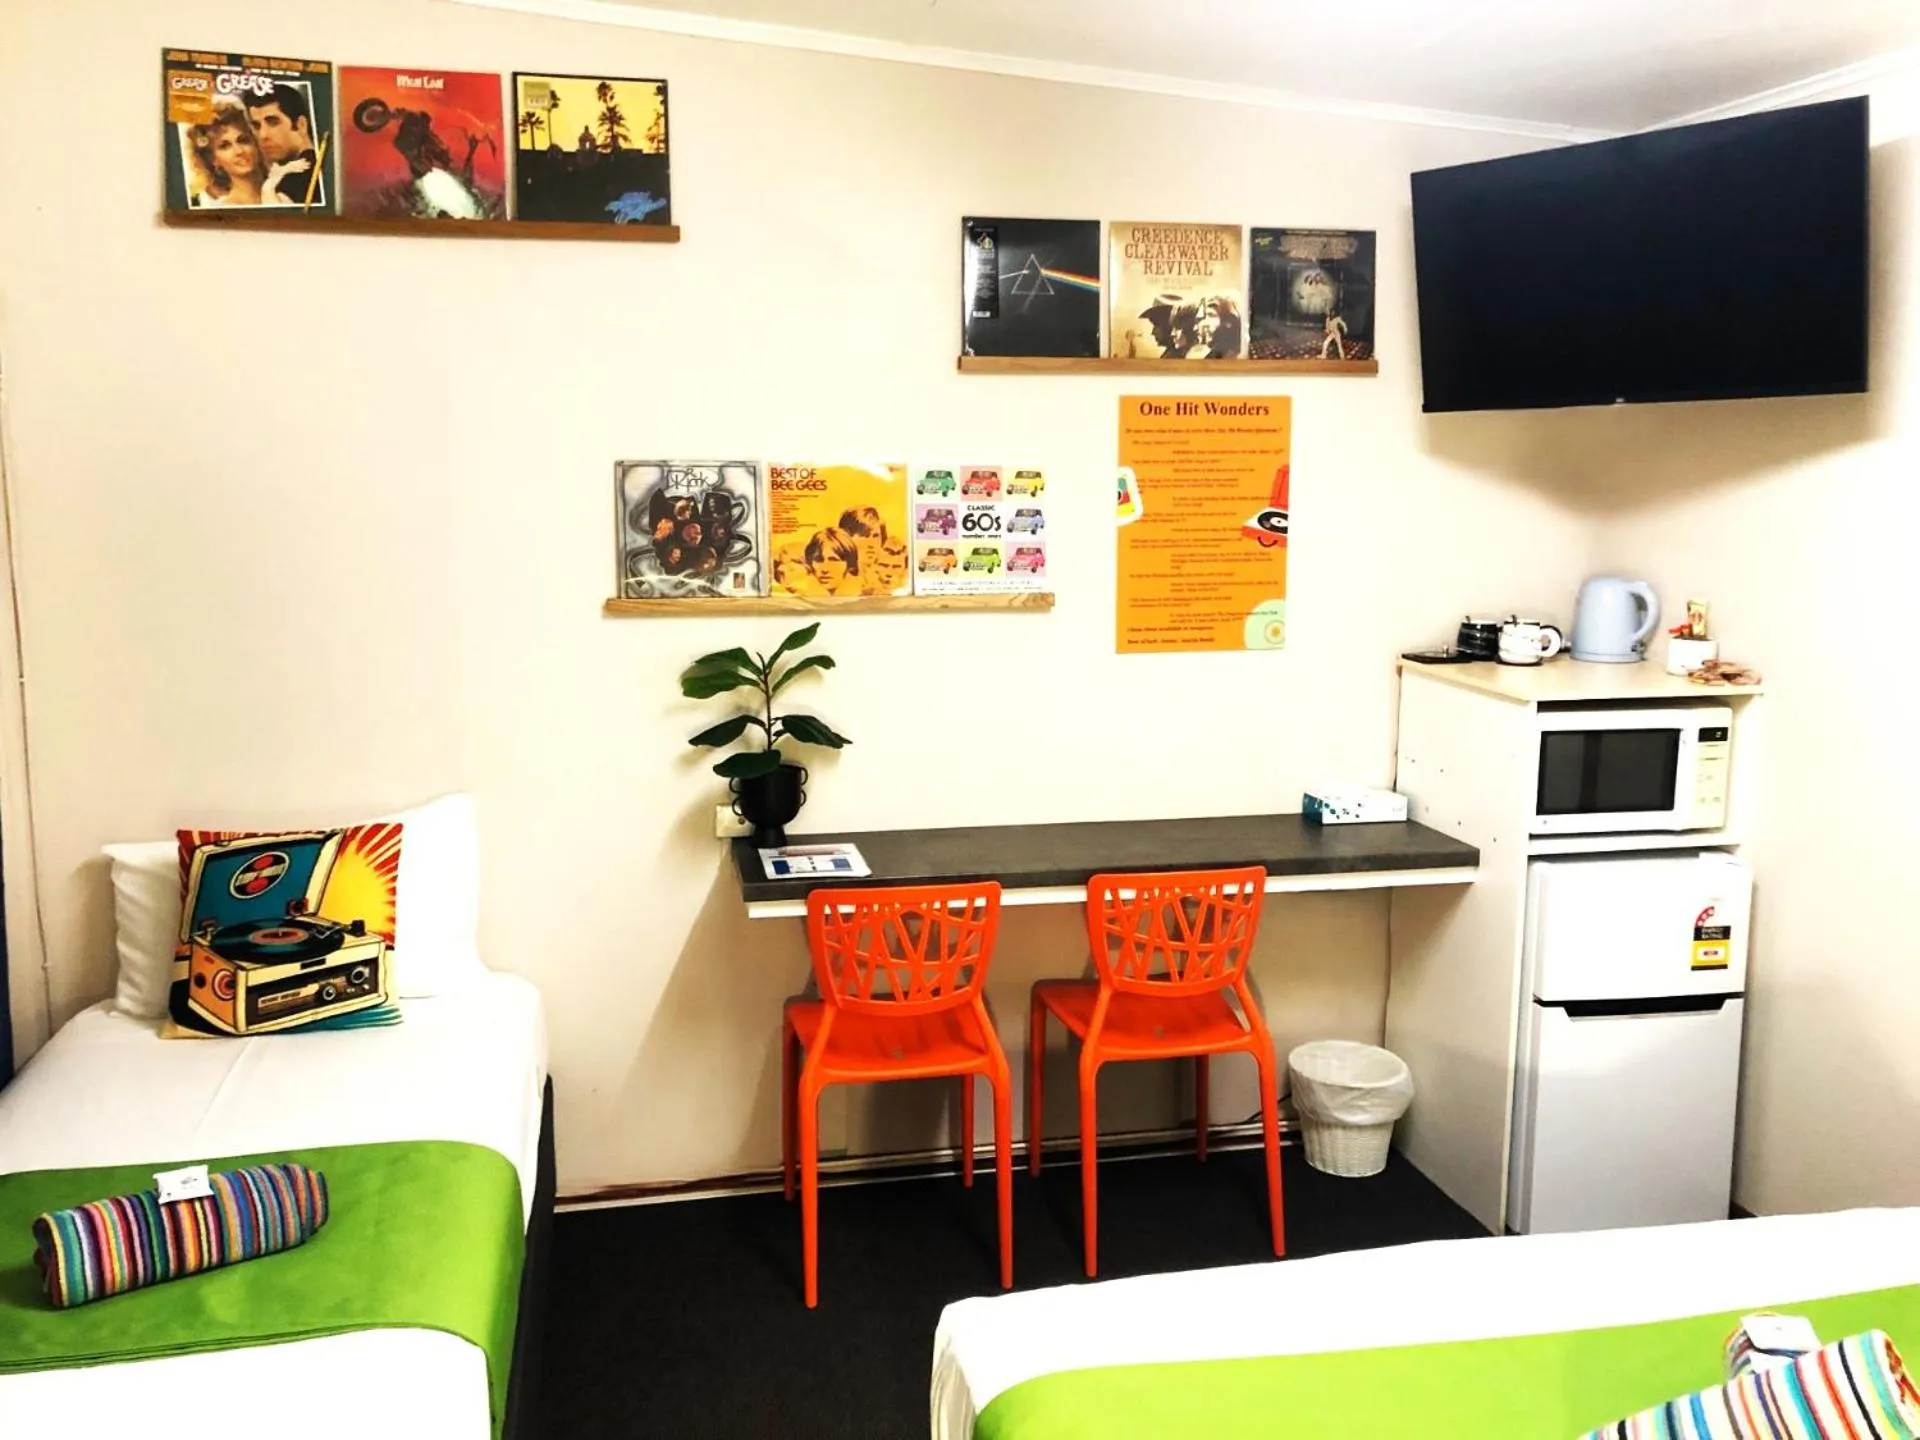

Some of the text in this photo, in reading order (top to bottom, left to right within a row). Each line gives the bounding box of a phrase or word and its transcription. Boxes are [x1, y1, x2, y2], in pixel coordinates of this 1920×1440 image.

[216, 73, 275, 97] GREASE
[1131, 227, 1224, 245] CREEDENCE
[1124, 243, 1229, 261] CLEARWATER
[1143, 260, 1213, 276] REVIVAL
[1139, 401, 1270, 416] One Hit Wonders
[770, 467, 816, 480] BEST OF
[771, 480, 828, 491] BEE GEES
[962, 512, 1002, 532] 60s
